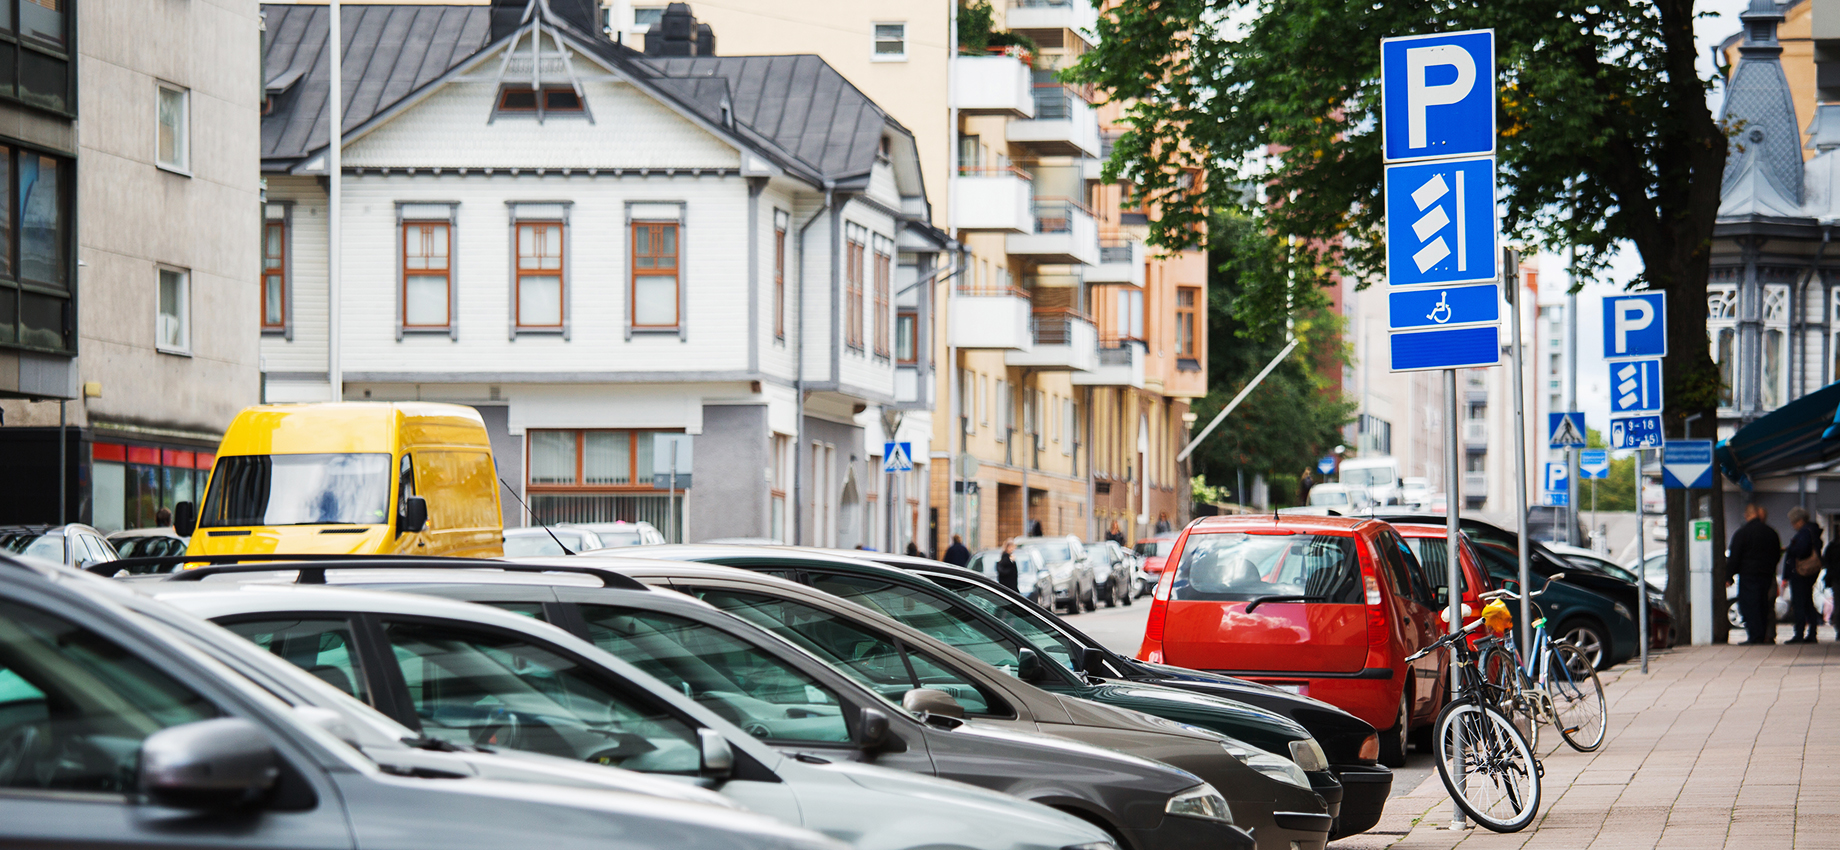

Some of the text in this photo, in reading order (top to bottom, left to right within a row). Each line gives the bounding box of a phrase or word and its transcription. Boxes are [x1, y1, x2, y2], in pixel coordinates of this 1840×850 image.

[1407, 44, 1476, 149] P
[1614, 299, 1655, 353] P
[1549, 464, 1567, 491] P
